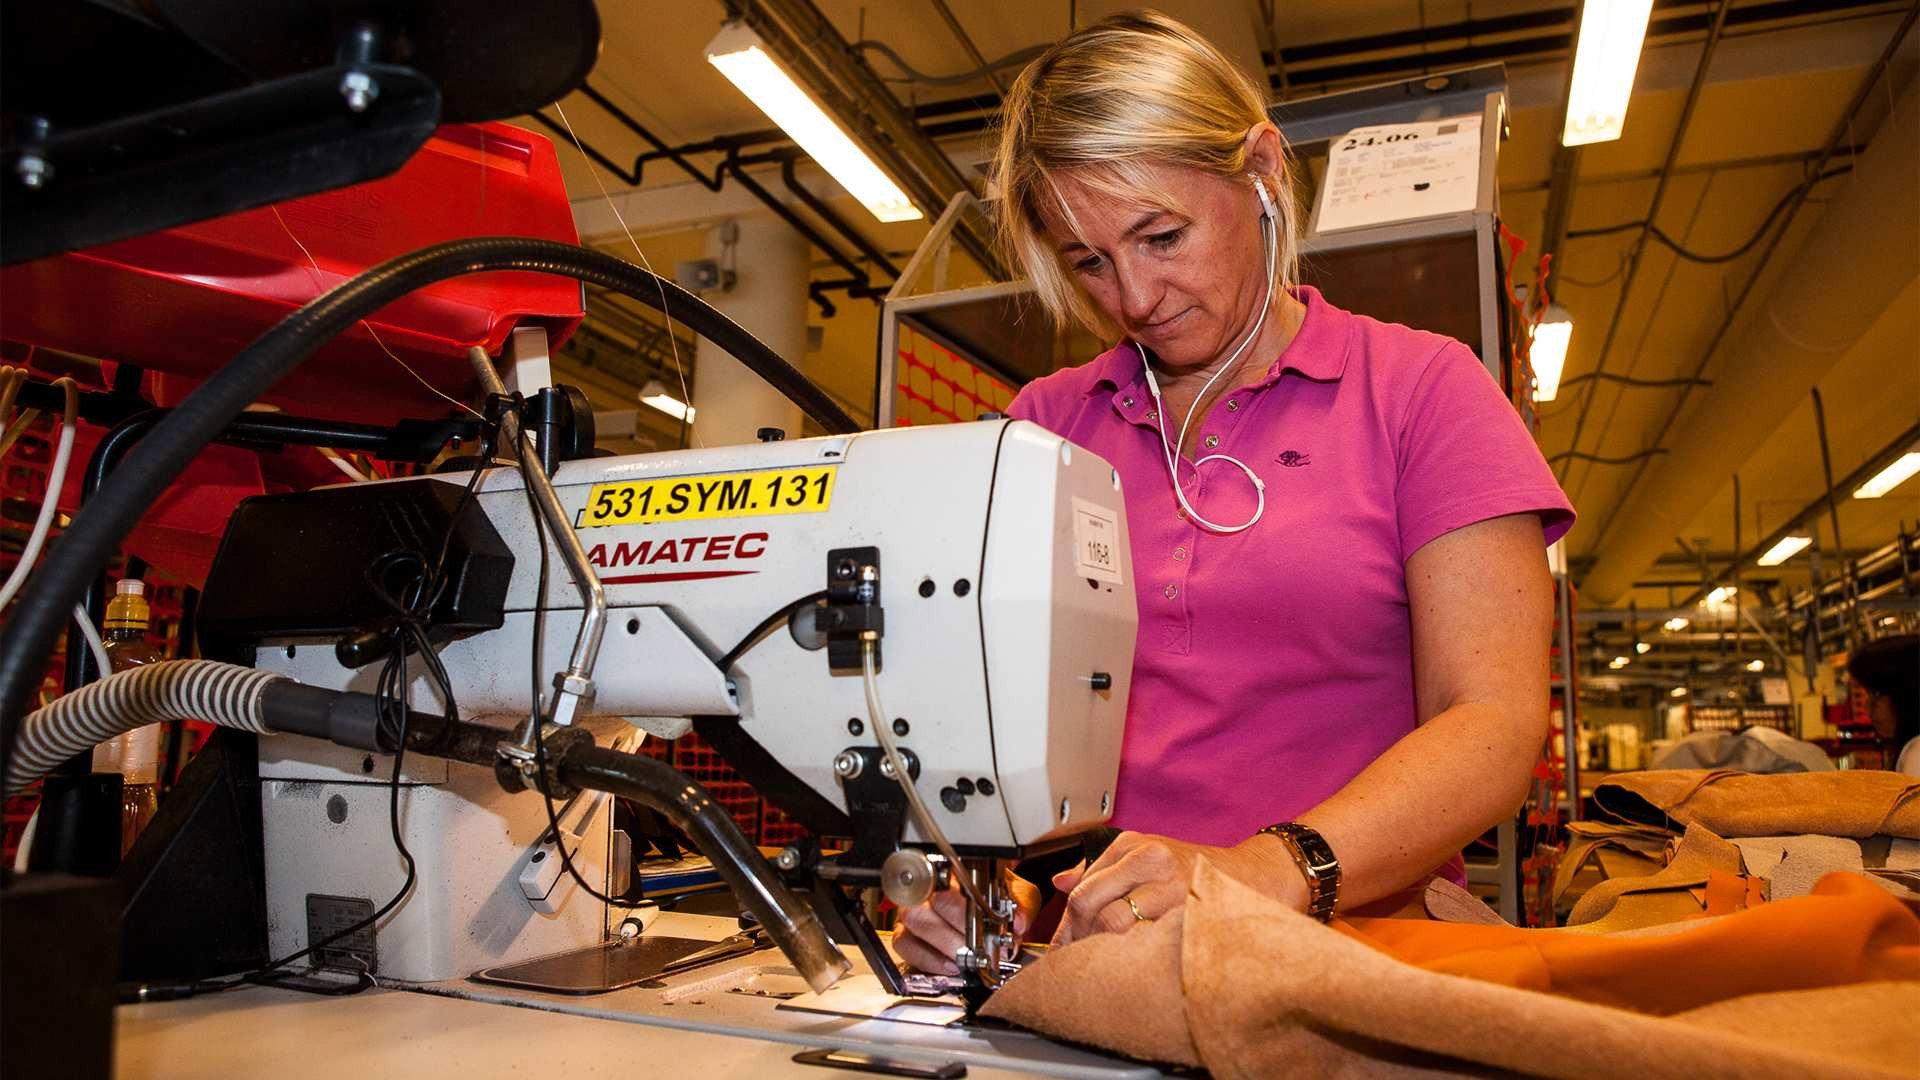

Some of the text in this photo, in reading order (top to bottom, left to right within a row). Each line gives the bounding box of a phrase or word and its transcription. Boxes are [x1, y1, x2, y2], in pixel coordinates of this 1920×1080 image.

[1343, 132, 1419, 152] 24.06
[594, 472, 831, 519] 531.SYM.131
[585, 532, 769, 568] AMATEC
